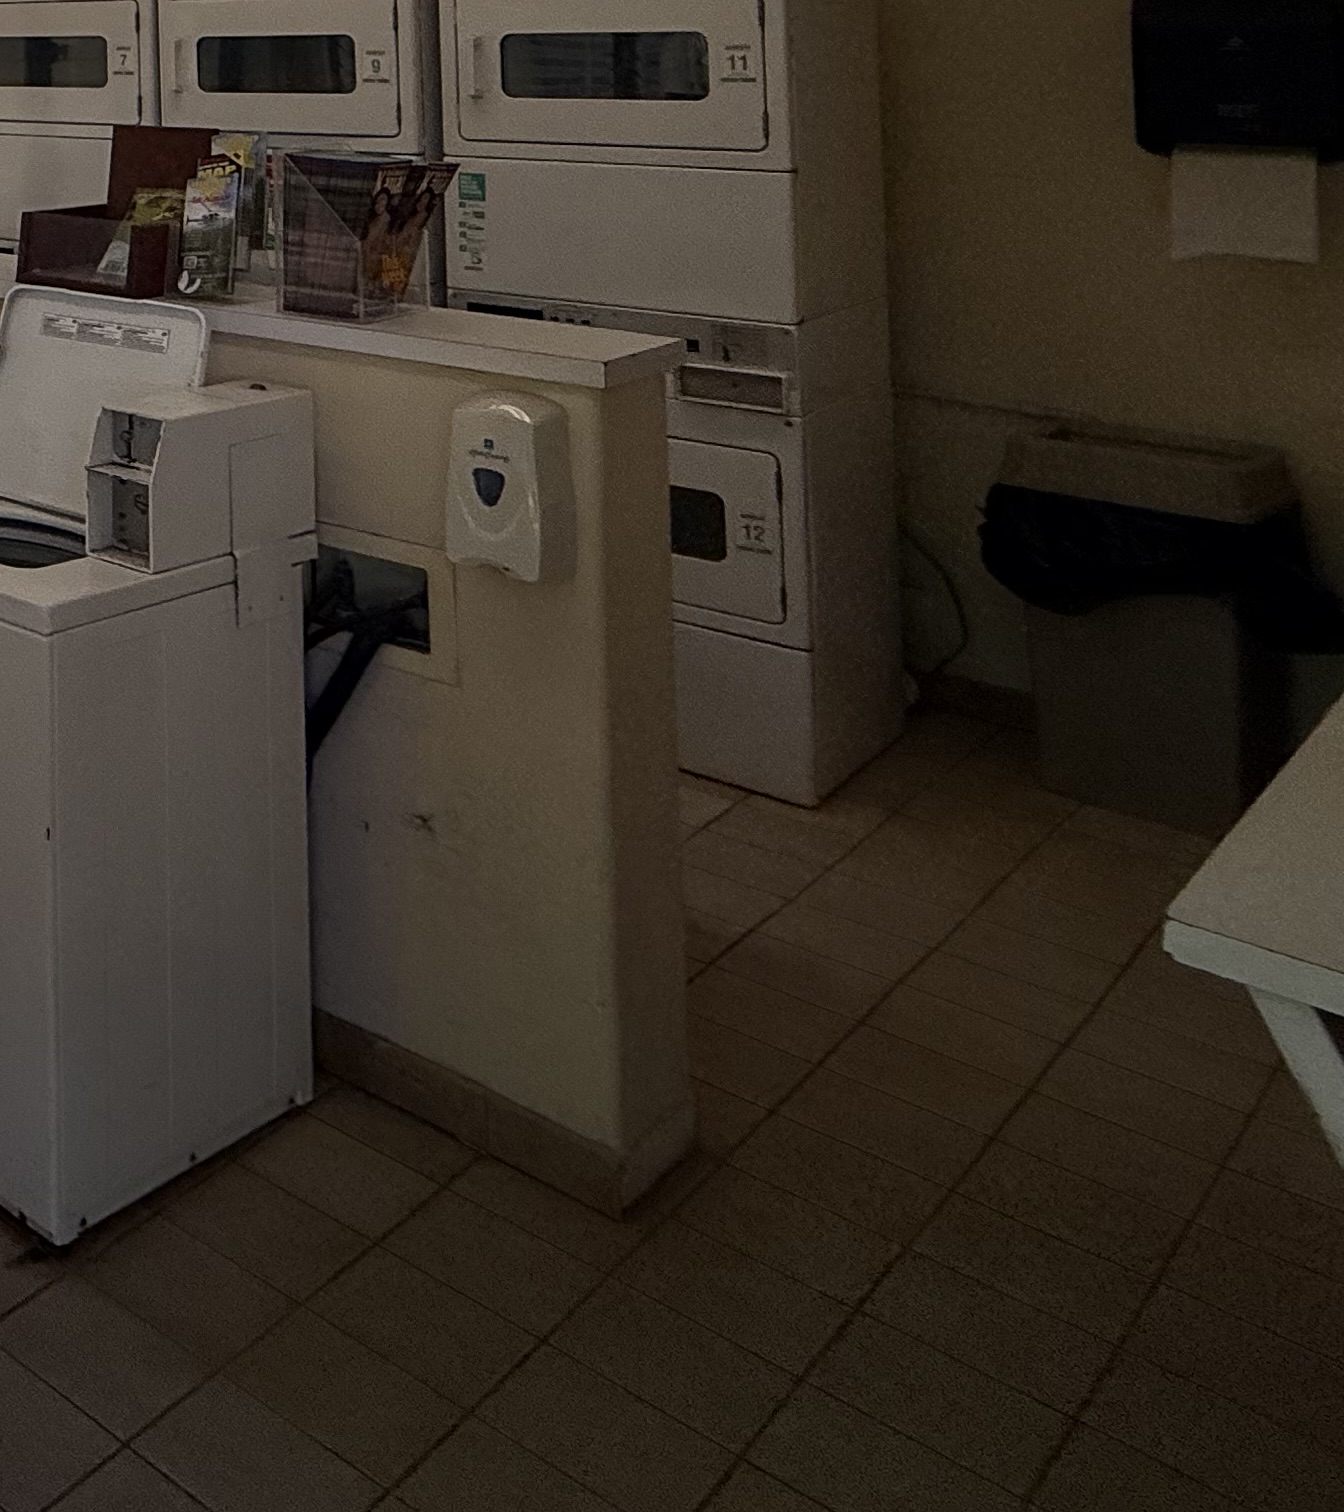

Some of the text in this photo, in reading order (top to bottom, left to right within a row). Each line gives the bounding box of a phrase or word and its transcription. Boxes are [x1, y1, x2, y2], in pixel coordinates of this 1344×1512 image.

[119, 54, 128, 66] 7
[371, 58, 381, 74] 9
[725, 54, 748, 71] 11
[740, 524, 766, 543] 12
